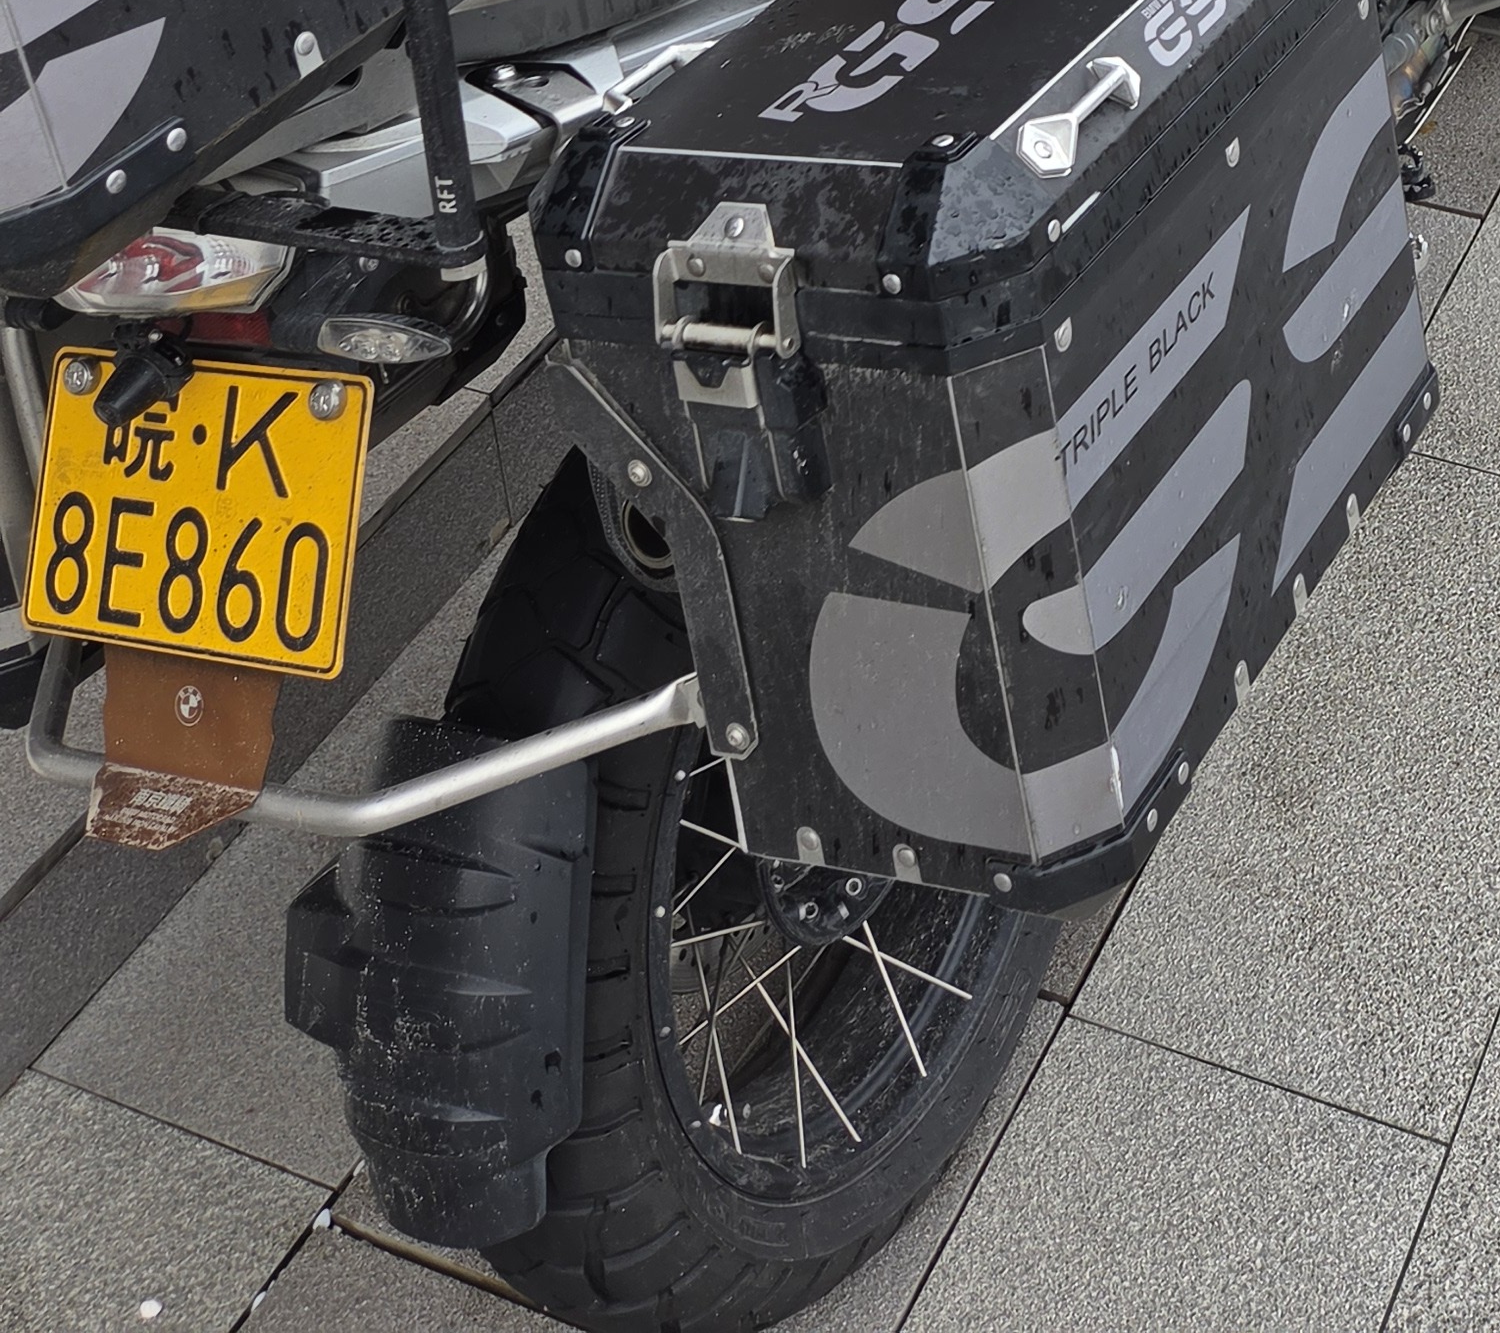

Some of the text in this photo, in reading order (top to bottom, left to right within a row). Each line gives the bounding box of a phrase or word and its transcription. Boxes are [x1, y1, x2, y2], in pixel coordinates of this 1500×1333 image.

[433, 174, 458, 214] RFT
[1054, 271, 1217, 473] TRIPLE BLACK
[44, 491, 330, 653] 8E860
